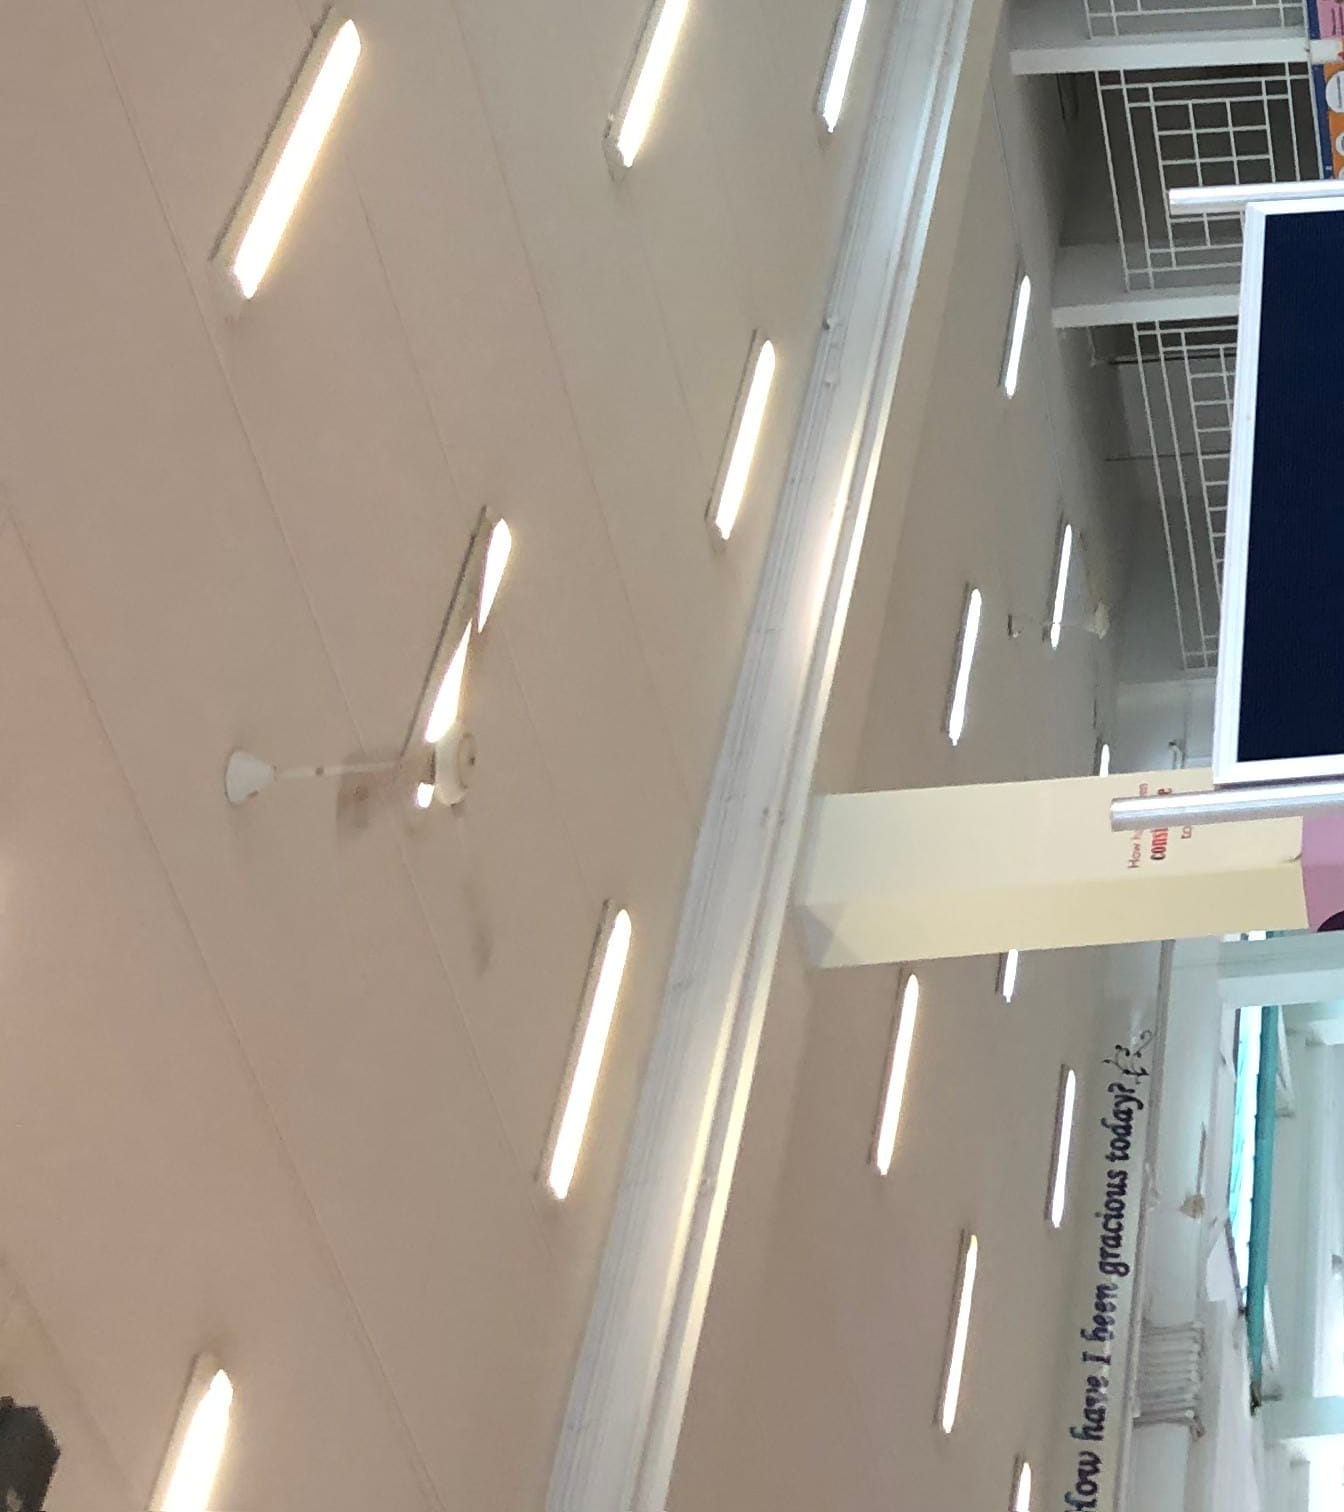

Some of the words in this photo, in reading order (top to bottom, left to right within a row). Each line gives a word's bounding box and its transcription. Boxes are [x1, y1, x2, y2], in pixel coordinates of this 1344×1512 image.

[1128, 843, 1141, 868] How
[1100, 1082, 1146, 1162] today?
[1095, 1169, 1130, 1277] gracious
[1080, 1284, 1117, 1342] been
[1081, 1351, 1112, 1366] I
[1069, 1375, 1109, 1440] have
